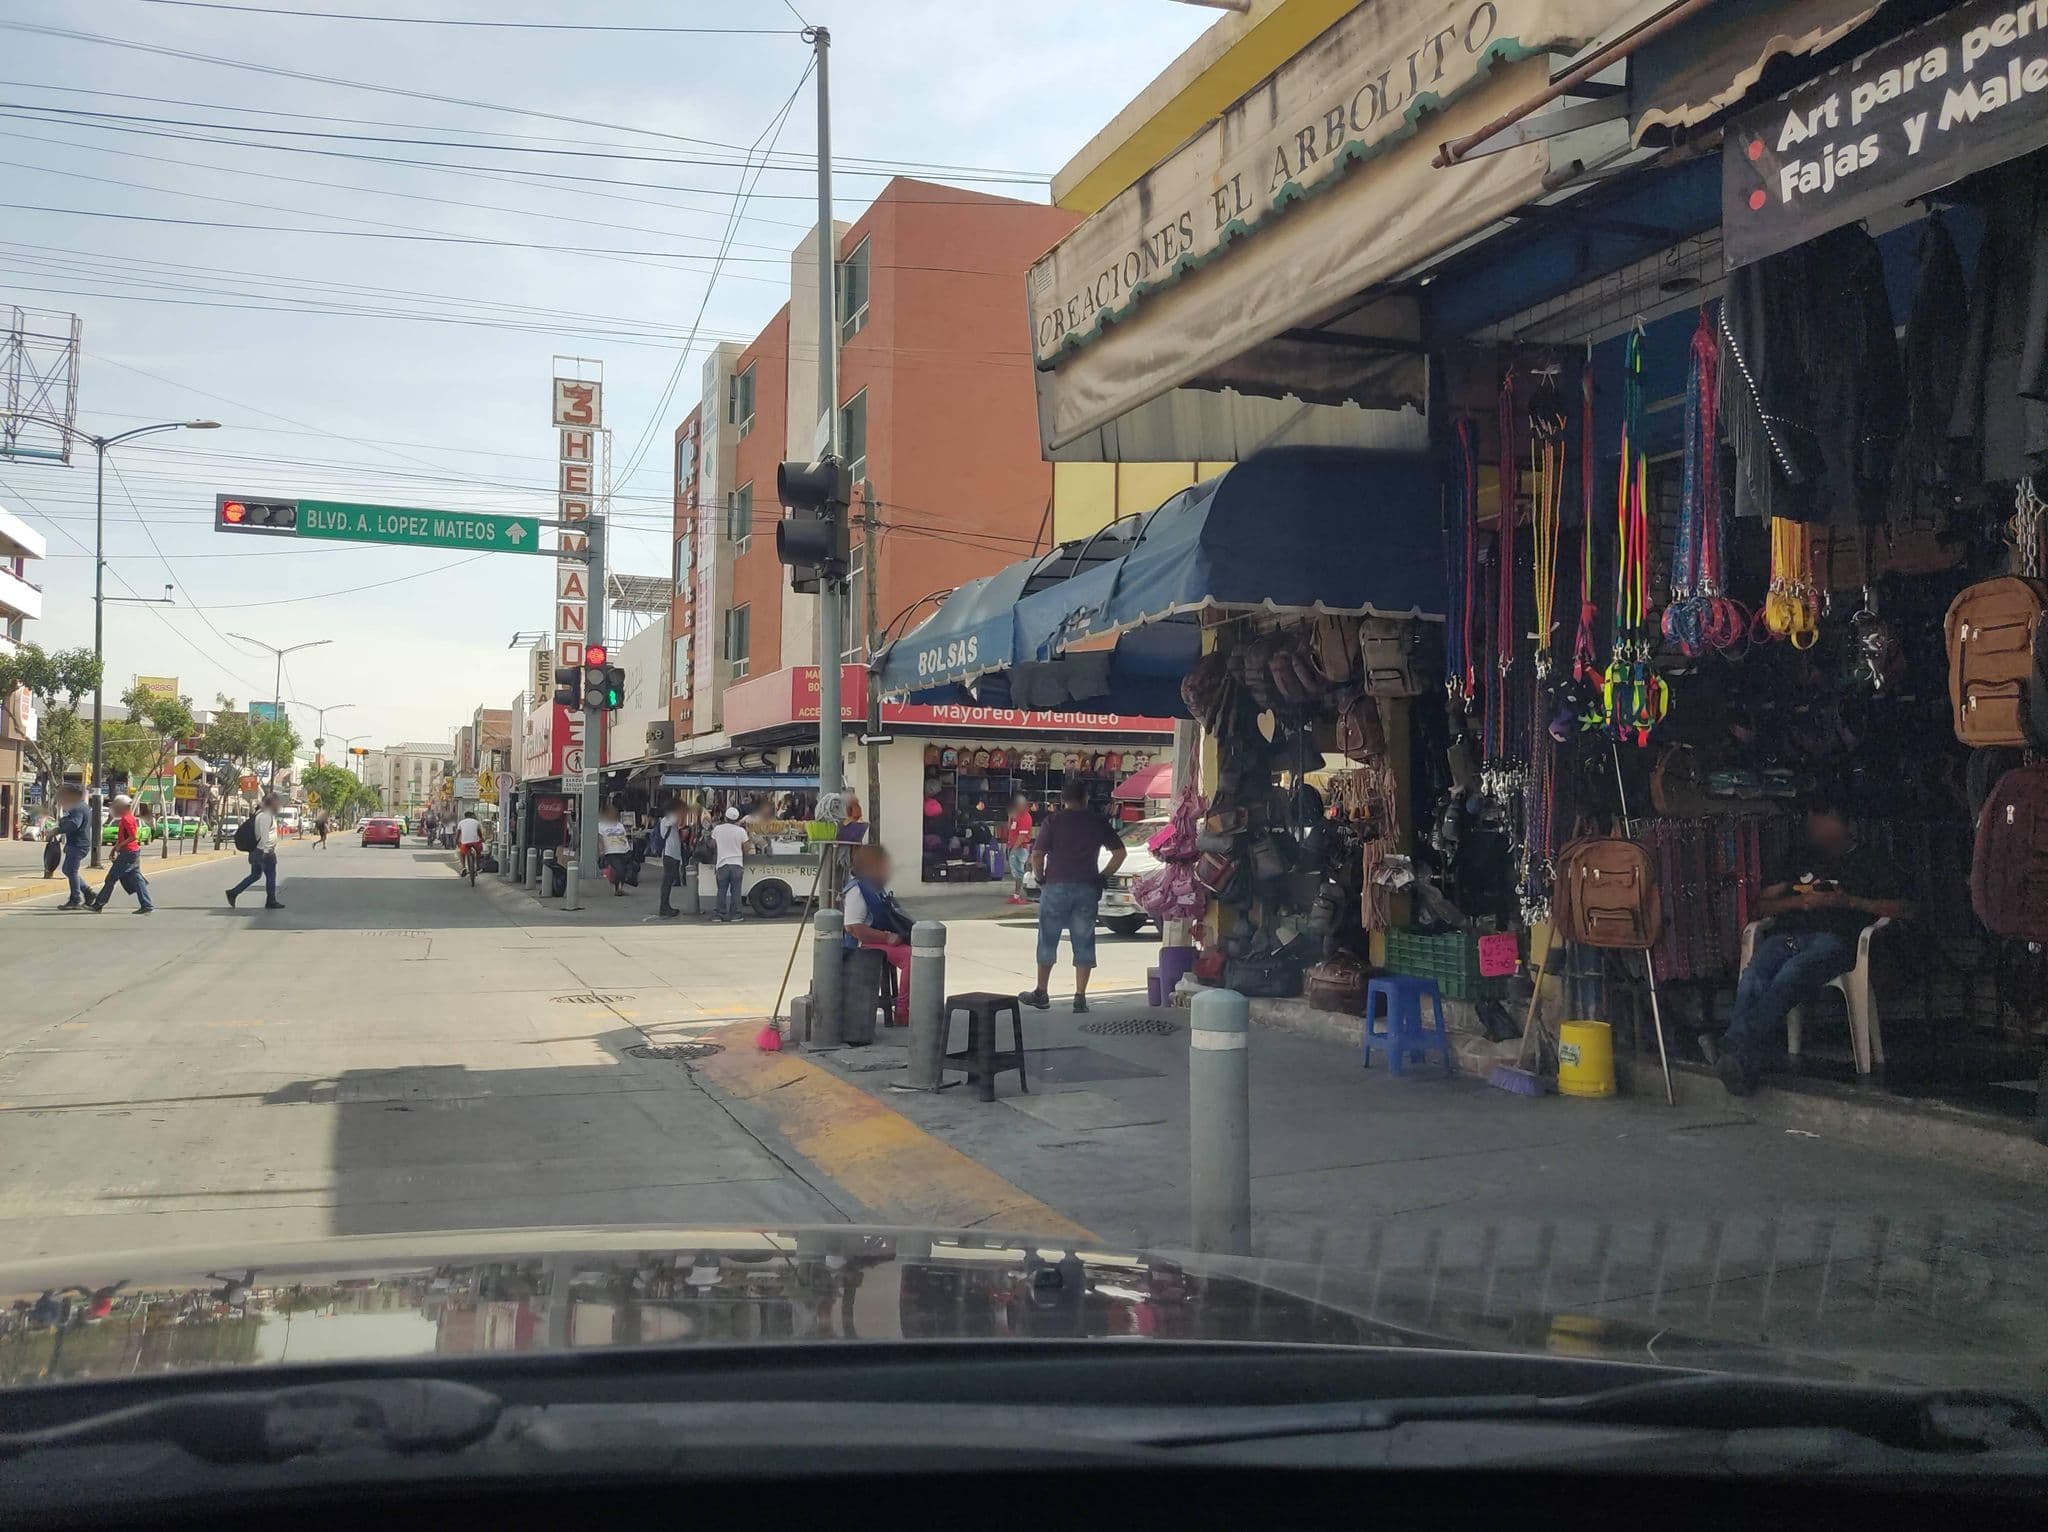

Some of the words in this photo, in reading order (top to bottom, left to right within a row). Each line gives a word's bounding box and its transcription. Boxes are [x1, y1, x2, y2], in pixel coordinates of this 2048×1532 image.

[1776, 92, 1840, 152] Art
[1850, 46, 1948, 127] para
[1039, 210, 1194, 348] CREACIONES
[1210, 172, 1253, 231] EL
[1269, 1, 1498, 194] ARBOLITO
[1779, 133, 1880, 205] Fajas
[1902, 111, 1929, 156] y
[306, 509, 352, 531] BLVD.
[356, 513, 372, 532] A.
[378, 514, 428, 537] LOPEZ
[433, 518, 496, 541] MATEOS
[918, 635, 978, 677] BOLSAS
[932, 703, 1014, 724] Mayoreo
[1020, 709, 1031, 726] y
